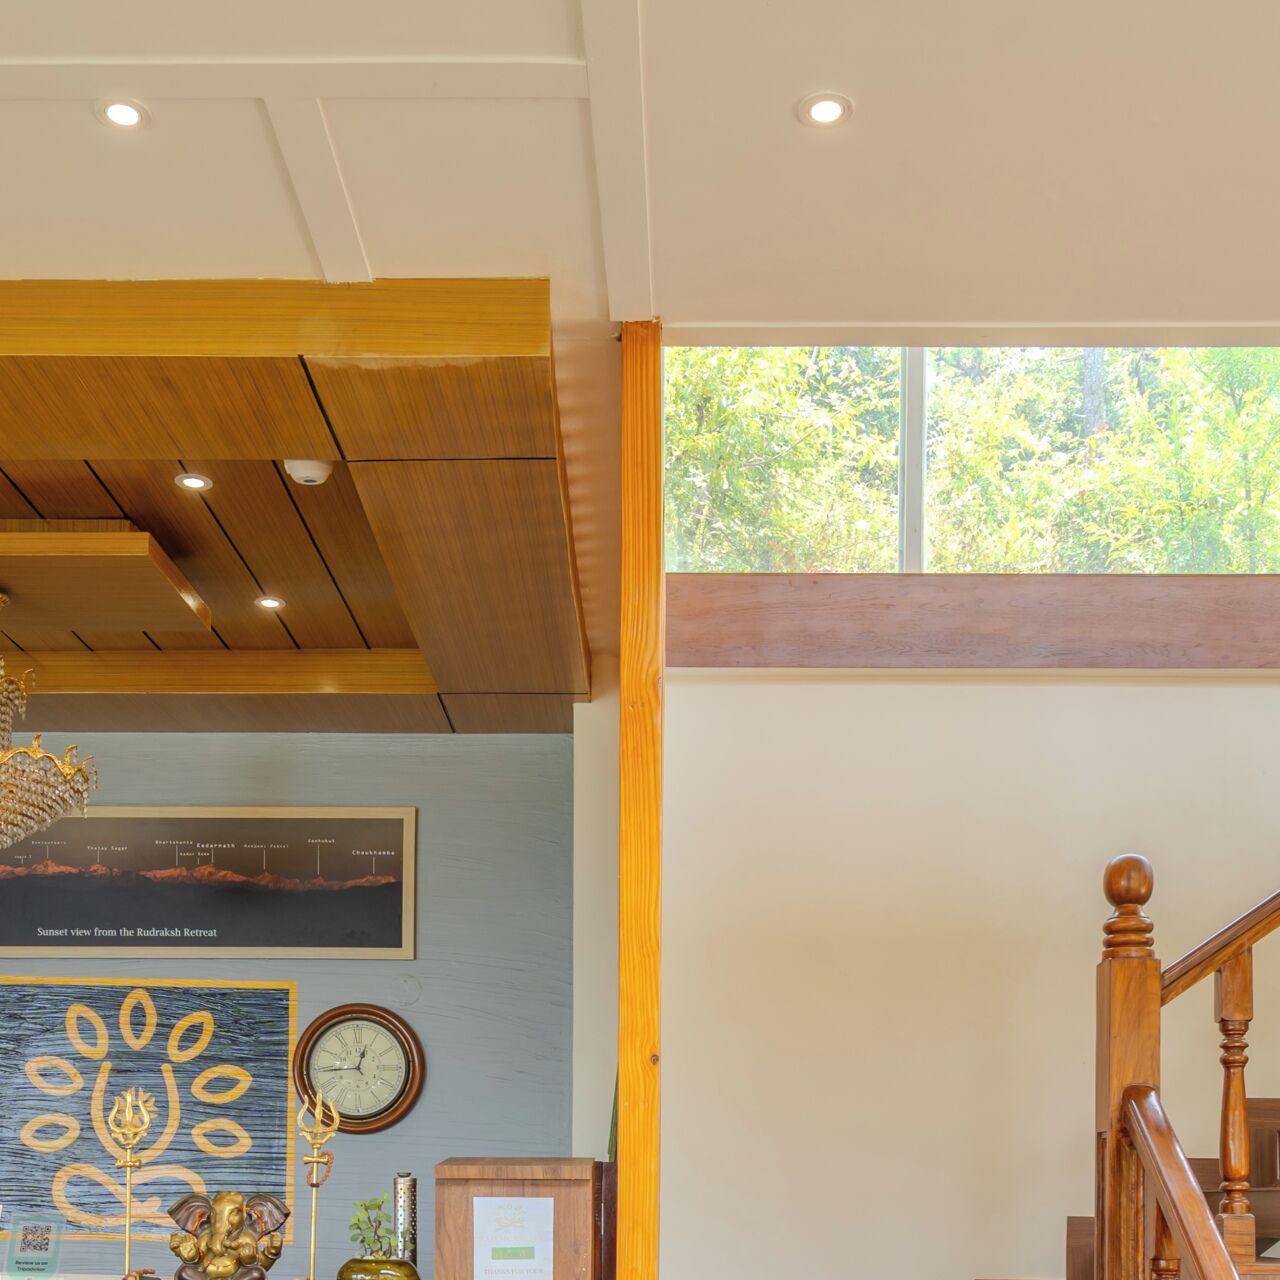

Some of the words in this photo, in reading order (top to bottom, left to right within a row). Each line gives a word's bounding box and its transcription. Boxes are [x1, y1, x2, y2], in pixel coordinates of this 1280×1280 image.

[37, 927, 68, 937] Sunset
[70, 927, 91, 937] view
[94, 927, 117, 937] from
[119, 927, 135, 937] the
[136, 927, 181, 937] Rudraksh
[183, 927, 218, 937] Retreat
